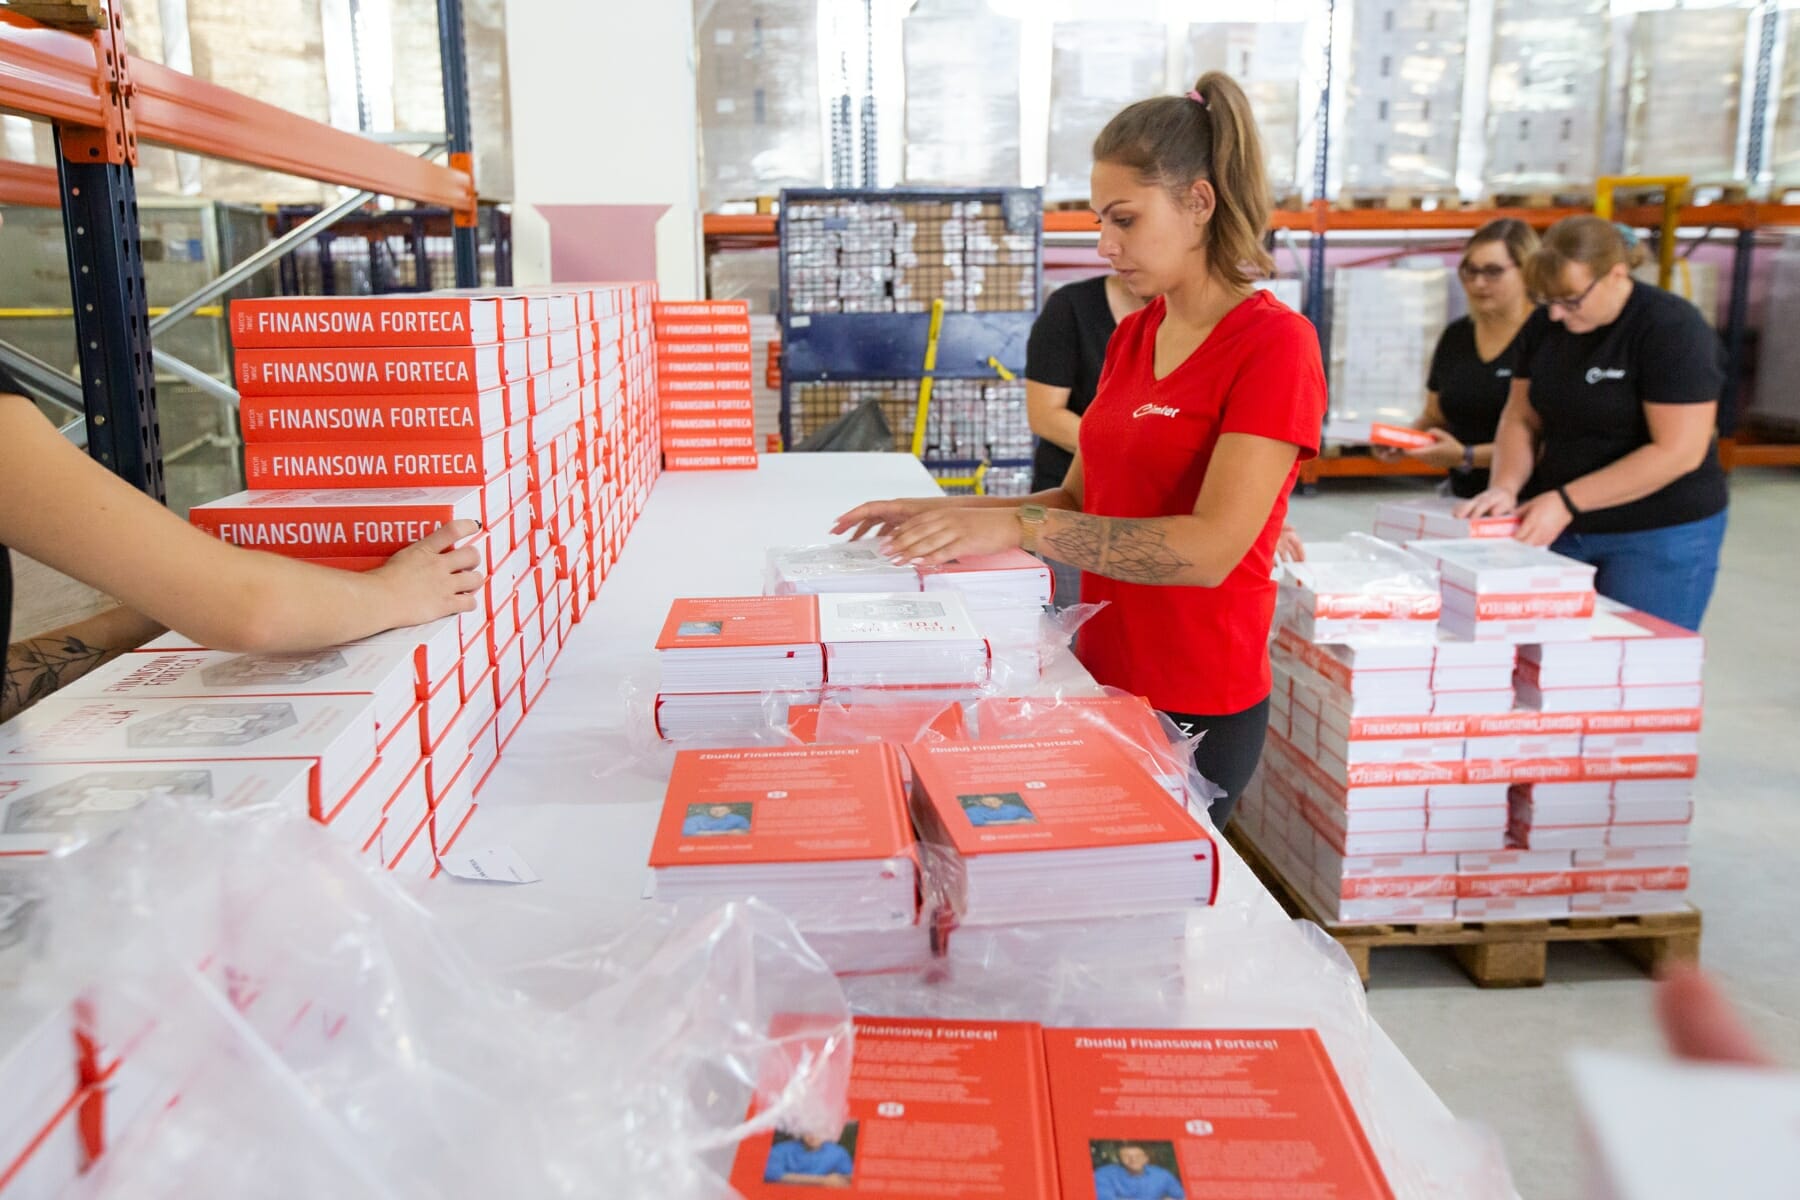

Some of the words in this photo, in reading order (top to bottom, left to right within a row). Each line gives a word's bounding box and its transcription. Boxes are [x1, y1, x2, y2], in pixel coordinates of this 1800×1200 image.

[258, 312, 374, 333] FINANSOWA
[381, 311, 465, 332] FORTECA
[263, 362, 379, 383] FINANSOWA
[385, 361, 469, 382] FORTECA
[269, 408, 384, 429] FINANSOWA
[390, 407, 474, 427] FORTECA
[273, 455, 388, 476] FINANSOWA
[394, 454, 477, 475] FORTECA
[220, 522, 347, 545] FINANSOWA
[1074, 1037, 1127, 1050] Zbuduj
[1131, 1038, 1212, 1050] Finansową
[1215, 1038, 1279, 1050] Fortecę!
